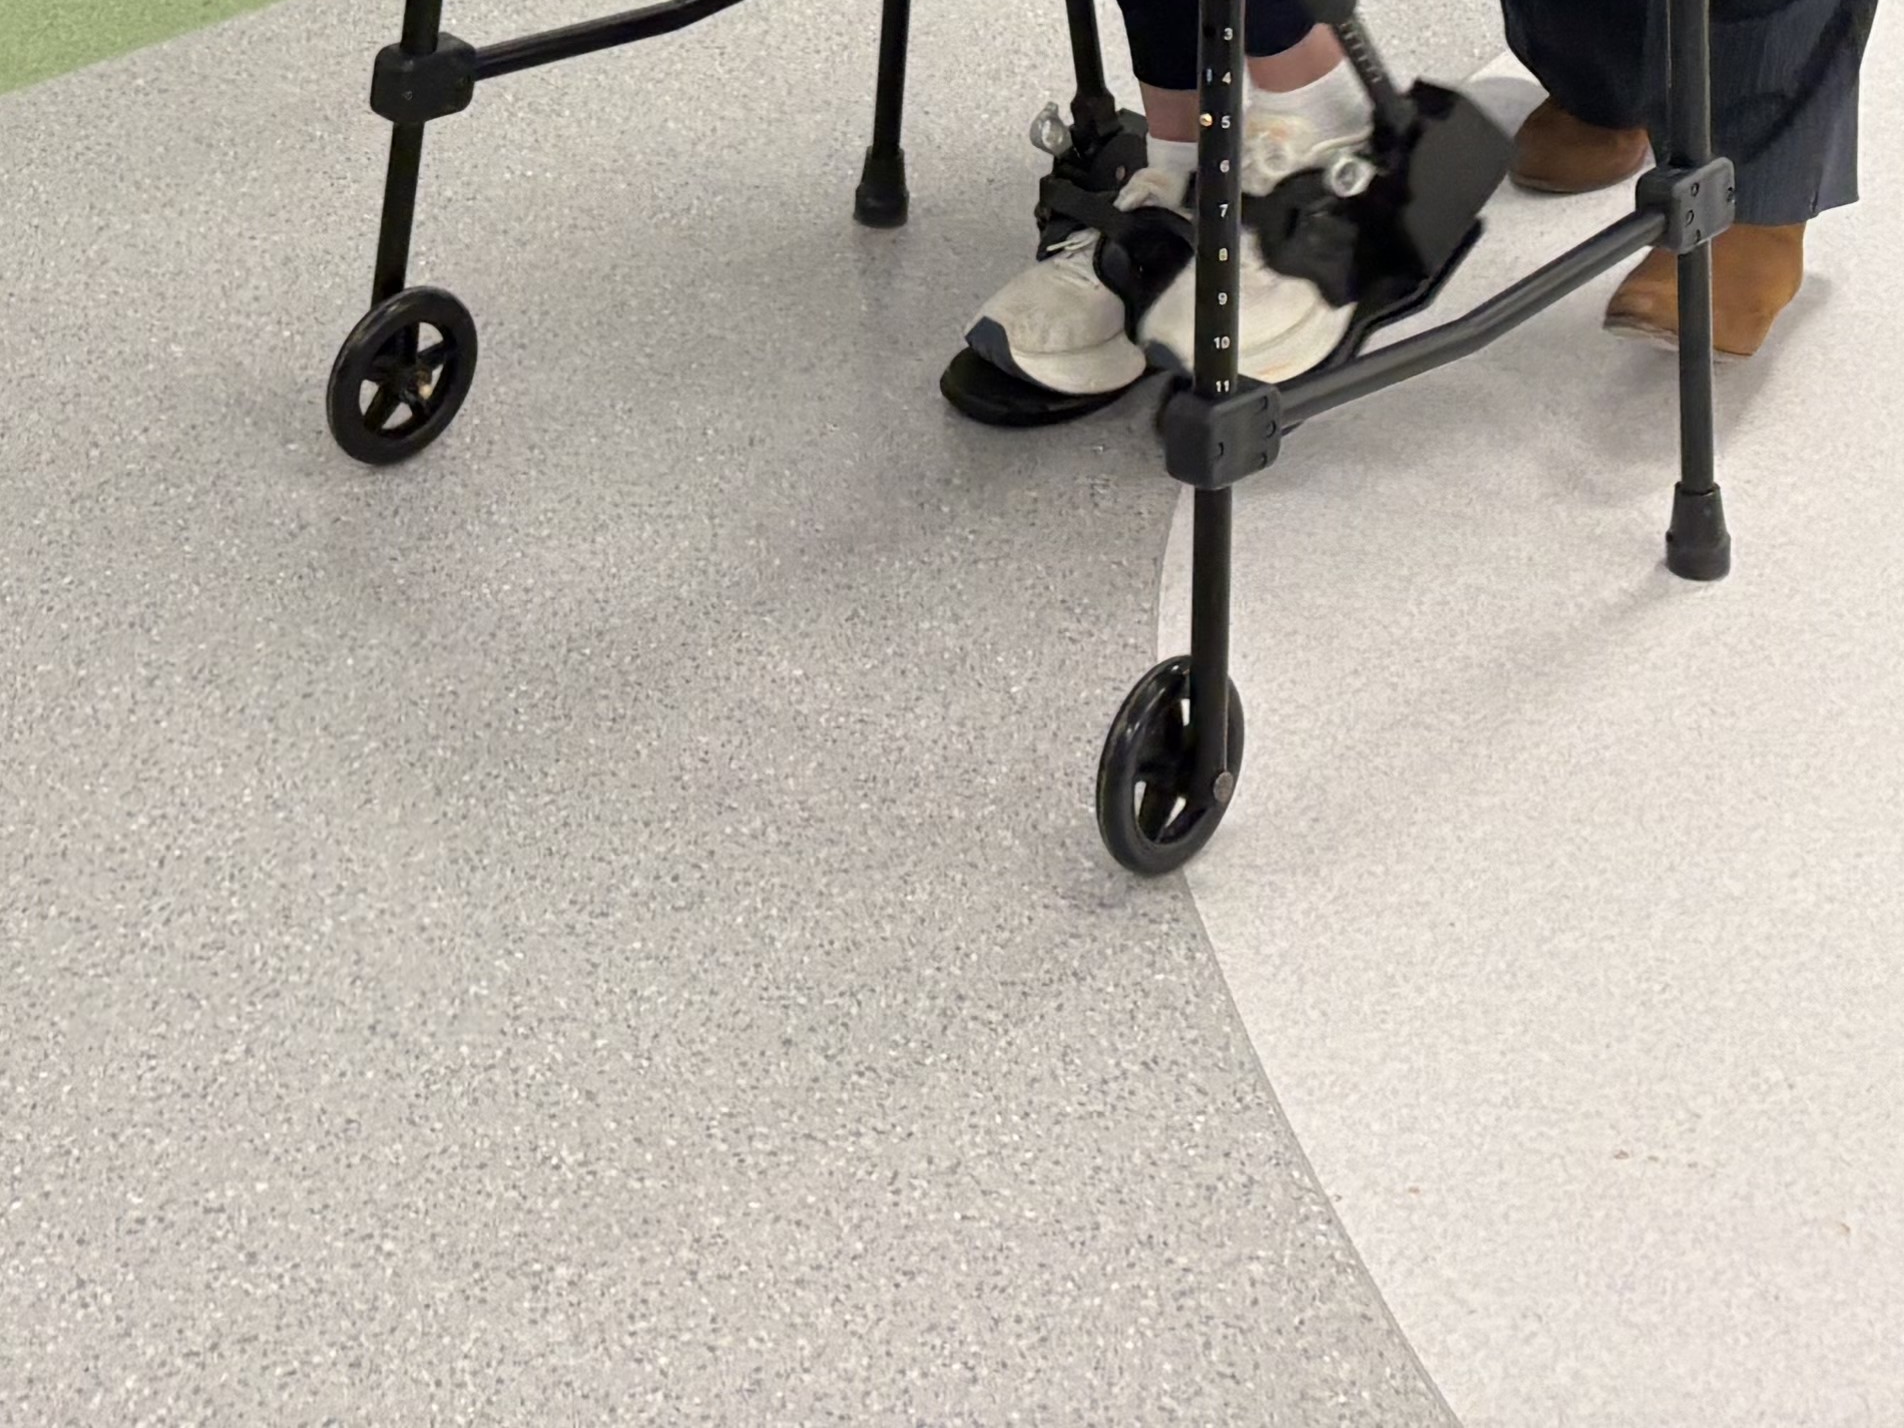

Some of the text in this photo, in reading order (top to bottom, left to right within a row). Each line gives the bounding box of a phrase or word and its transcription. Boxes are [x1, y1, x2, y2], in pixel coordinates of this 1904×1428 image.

[1224, 28, 1234, 41] 3
[1222, 71, 1232, 85] 4
[1221, 116, 1231, 129] 5
[1219, 159, 1230, 173] 6
[1219, 203, 1229, 218] 7
[1218, 247, 1229, 262] 8
[1217, 292, 1228, 306] 9
[1213, 336, 1231, 350] 10
[1215, 380, 1230, 393] 11
